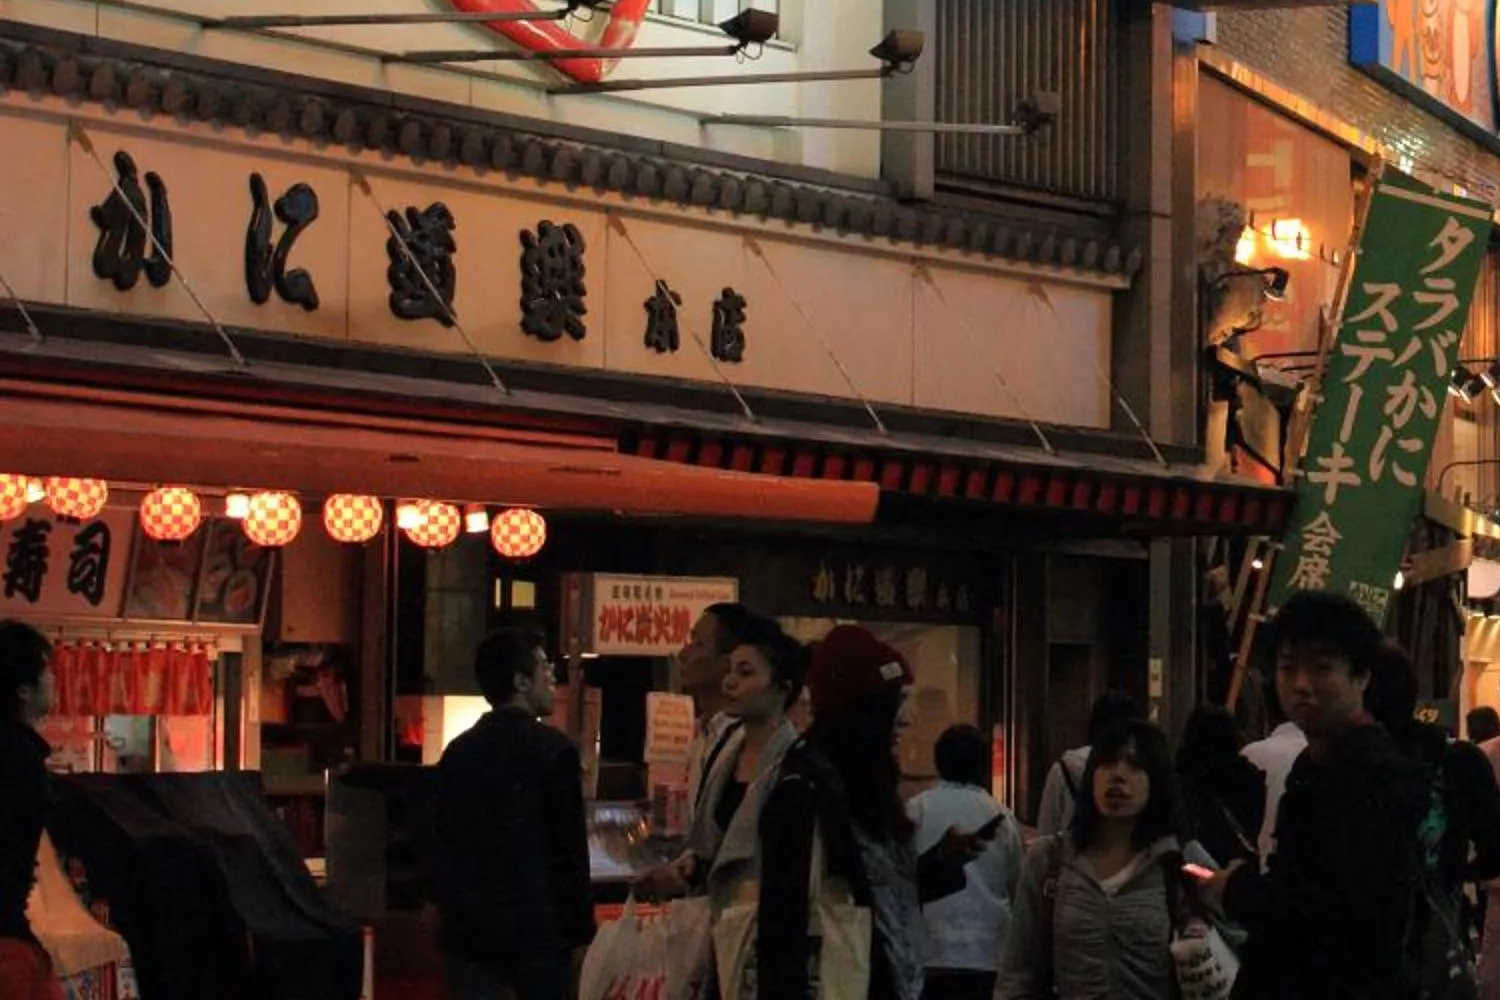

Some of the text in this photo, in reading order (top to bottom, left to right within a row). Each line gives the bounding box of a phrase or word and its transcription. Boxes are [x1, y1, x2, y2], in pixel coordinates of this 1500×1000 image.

[1368, 216, 1476, 487] タラバかに
[4, 518, 111, 606] 寿司
